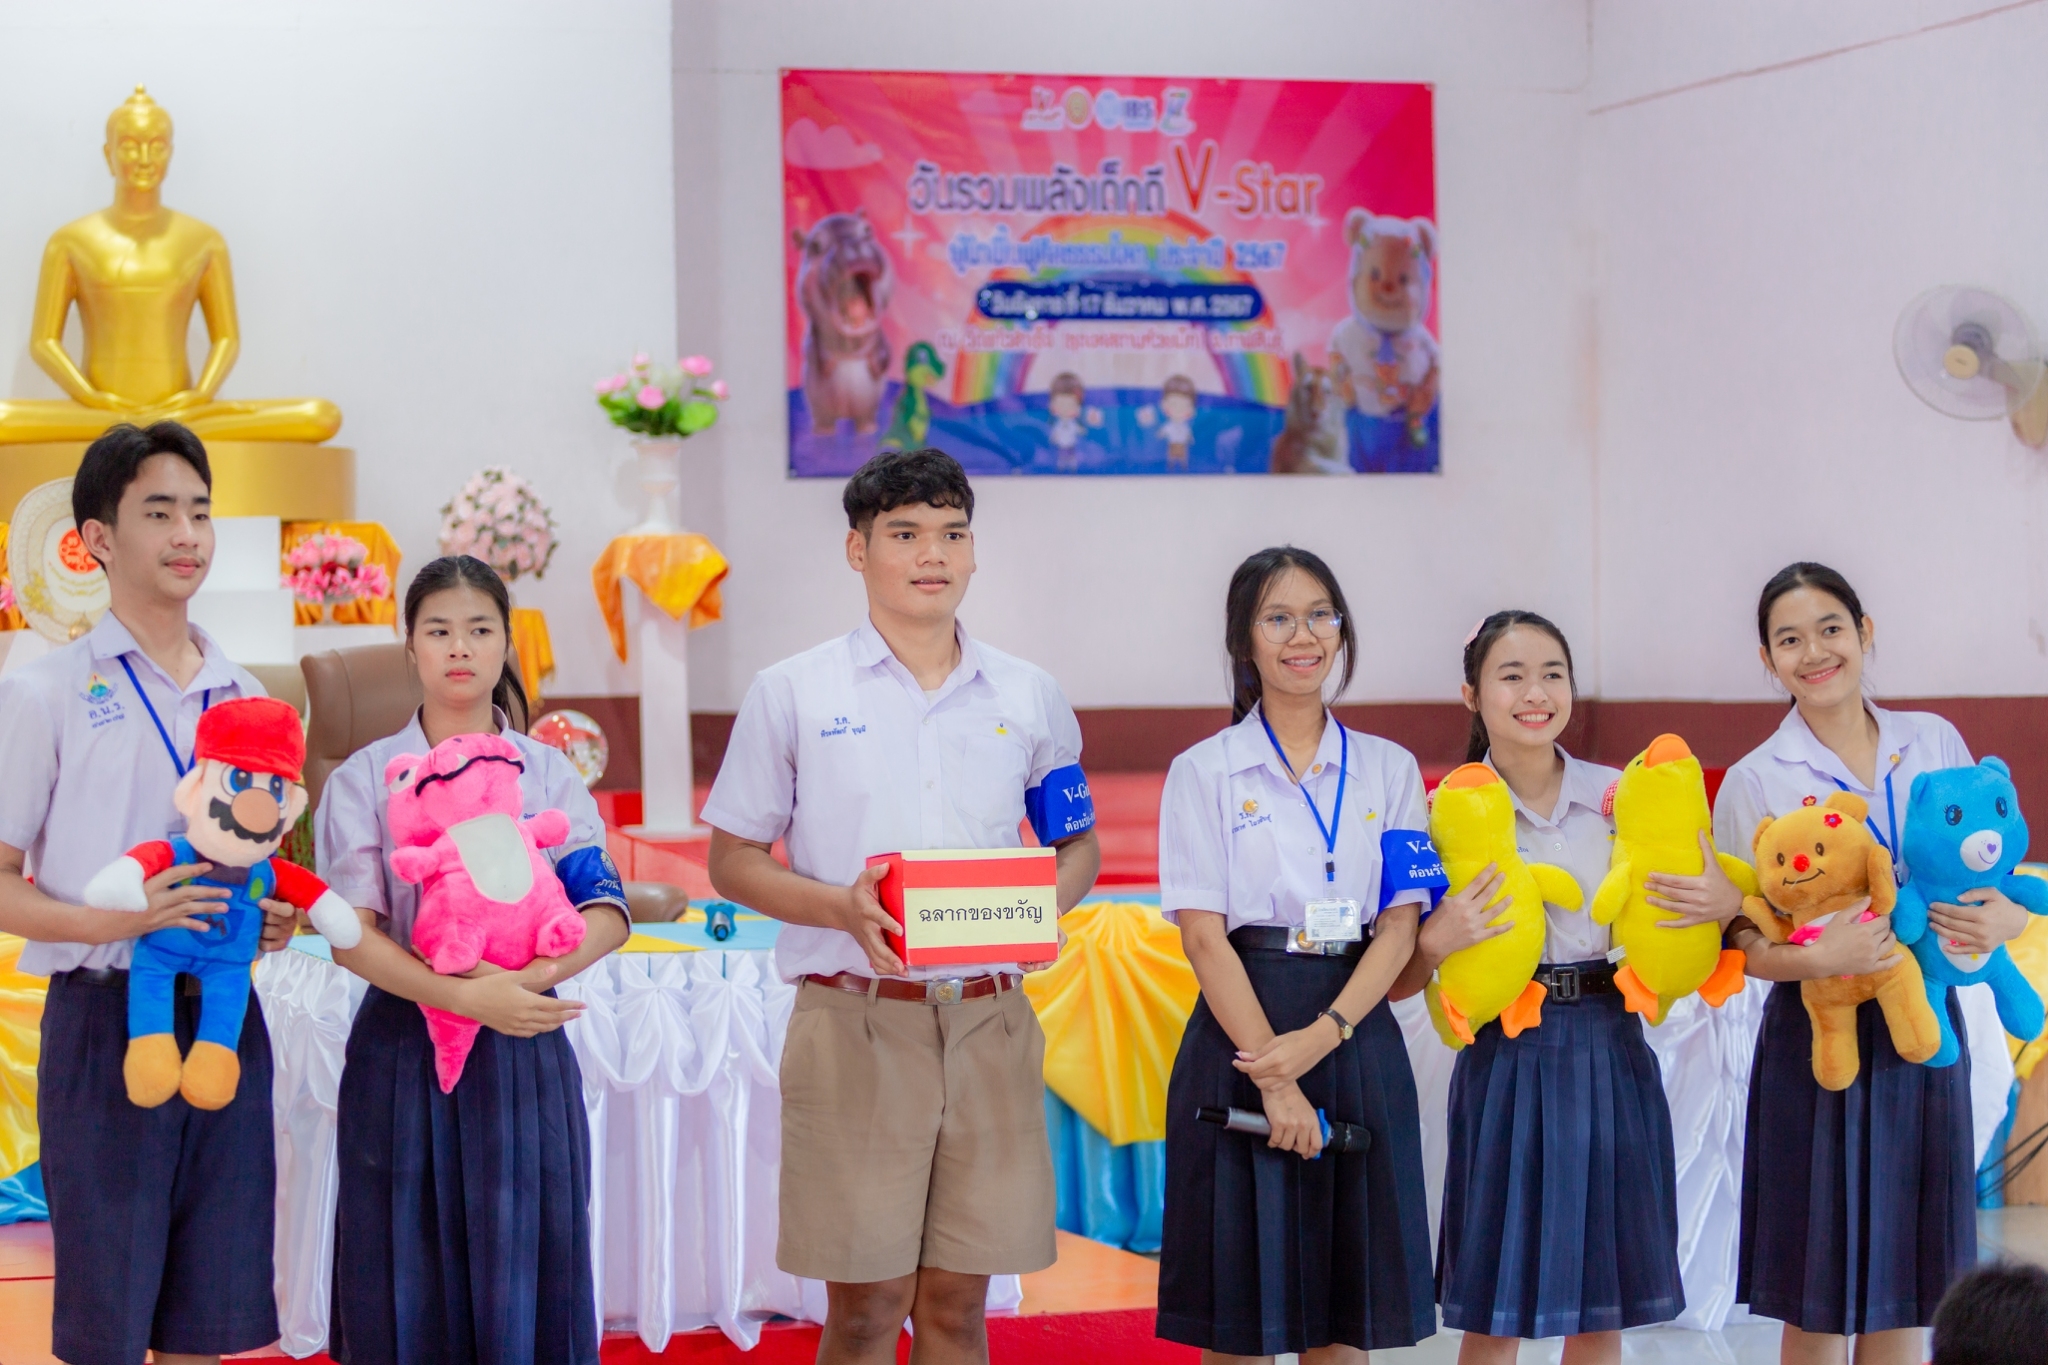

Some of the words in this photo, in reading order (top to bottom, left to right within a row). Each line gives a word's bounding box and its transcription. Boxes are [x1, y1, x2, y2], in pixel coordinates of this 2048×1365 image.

[909, 161, 1166, 211] วันรวมพลังเด็กดี
[1174, 145, 1320, 214] V-Star
[1236, 242, 1286, 268] 2567
[918, 898, 1043, 924] ฉลากของขวัญ
